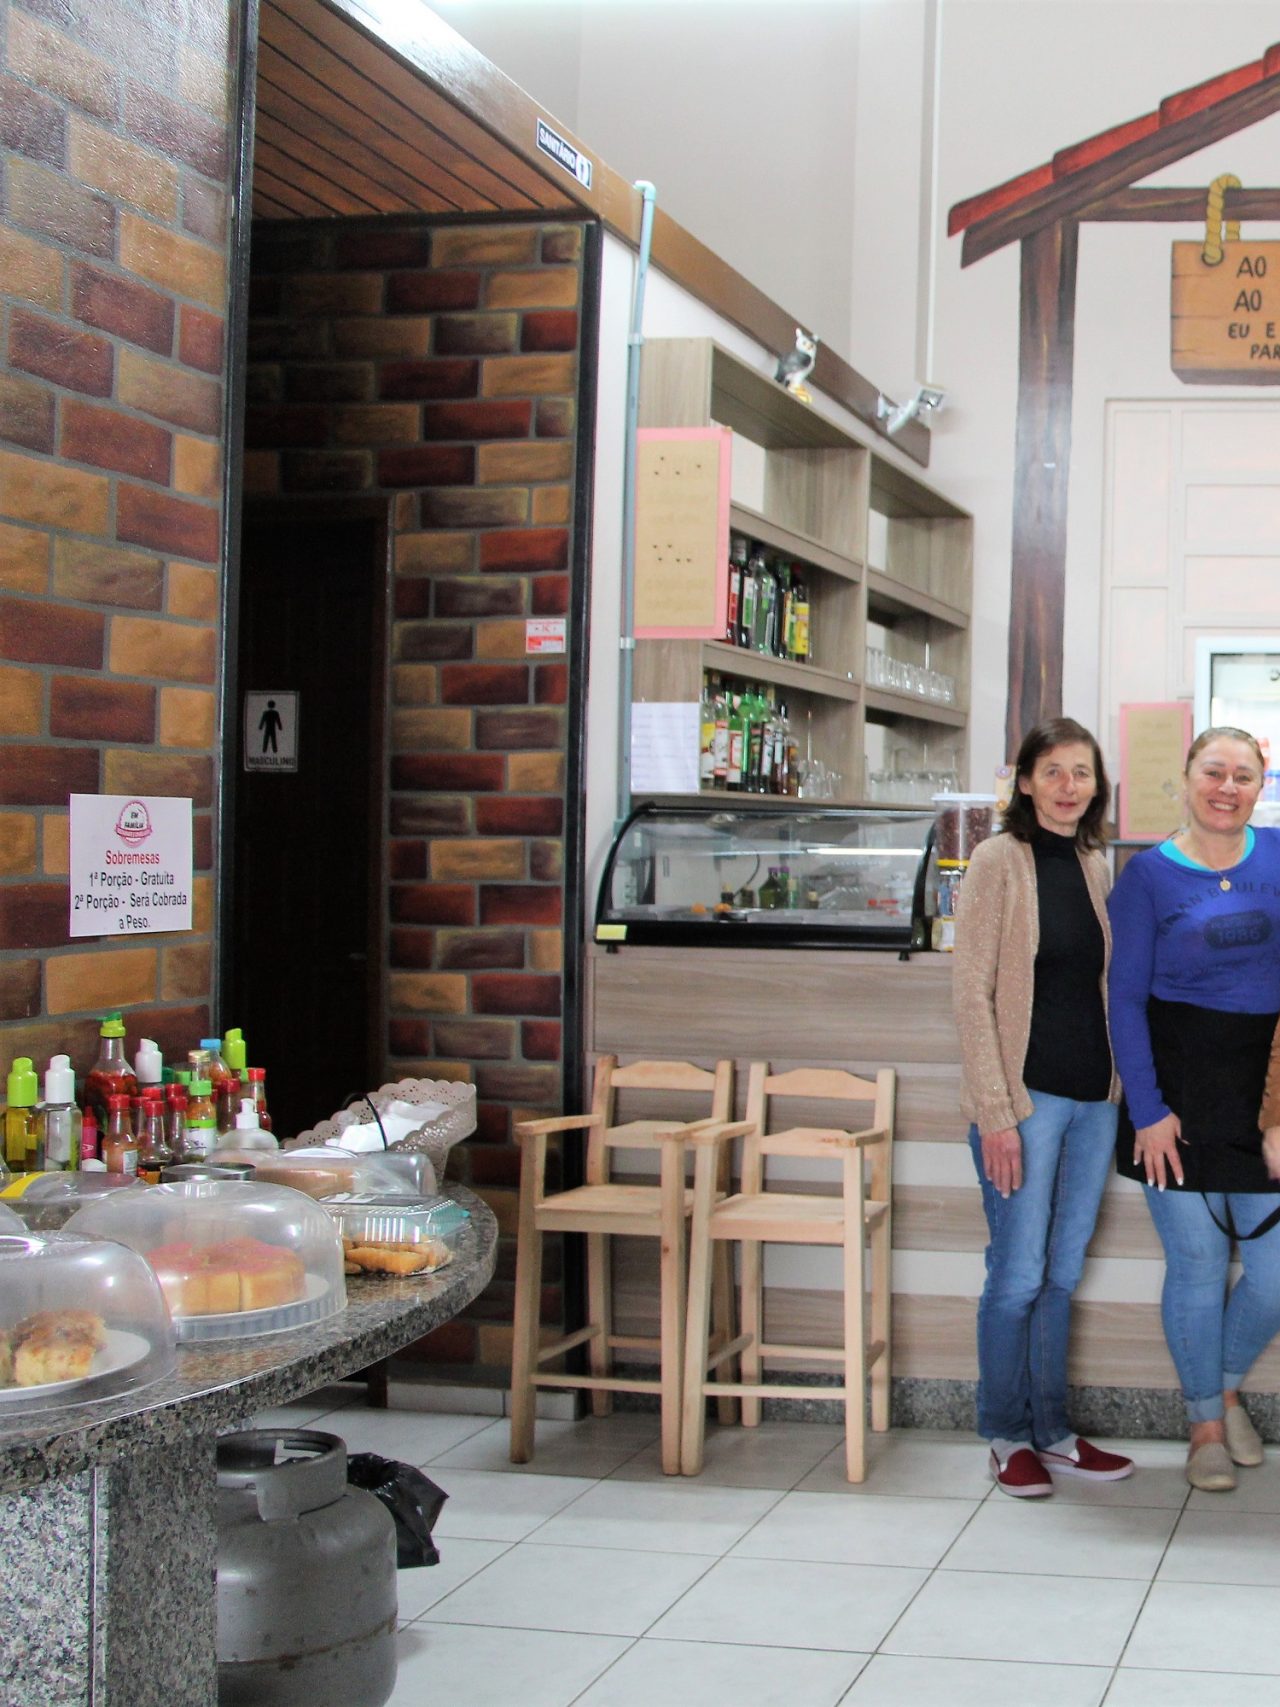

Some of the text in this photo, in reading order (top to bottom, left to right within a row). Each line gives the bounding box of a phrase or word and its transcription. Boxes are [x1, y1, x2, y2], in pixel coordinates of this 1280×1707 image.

[1236, 256, 1267, 278] AO
[1233, 289, 1262, 312] AO
[1228, 322, 1250, 339] EU
[1266, 322, 1276, 338] E
[105, 850, 160, 865] Sobremesas
[100, 871, 133, 890] Porção
[140, 871, 175, 887] Gratuita
[86, 894, 119, 912] Porção
[130, 892, 150, 908] Será
[152, 891, 187, 907] Cobrada
[119, 914, 151, 930] a Peso.
